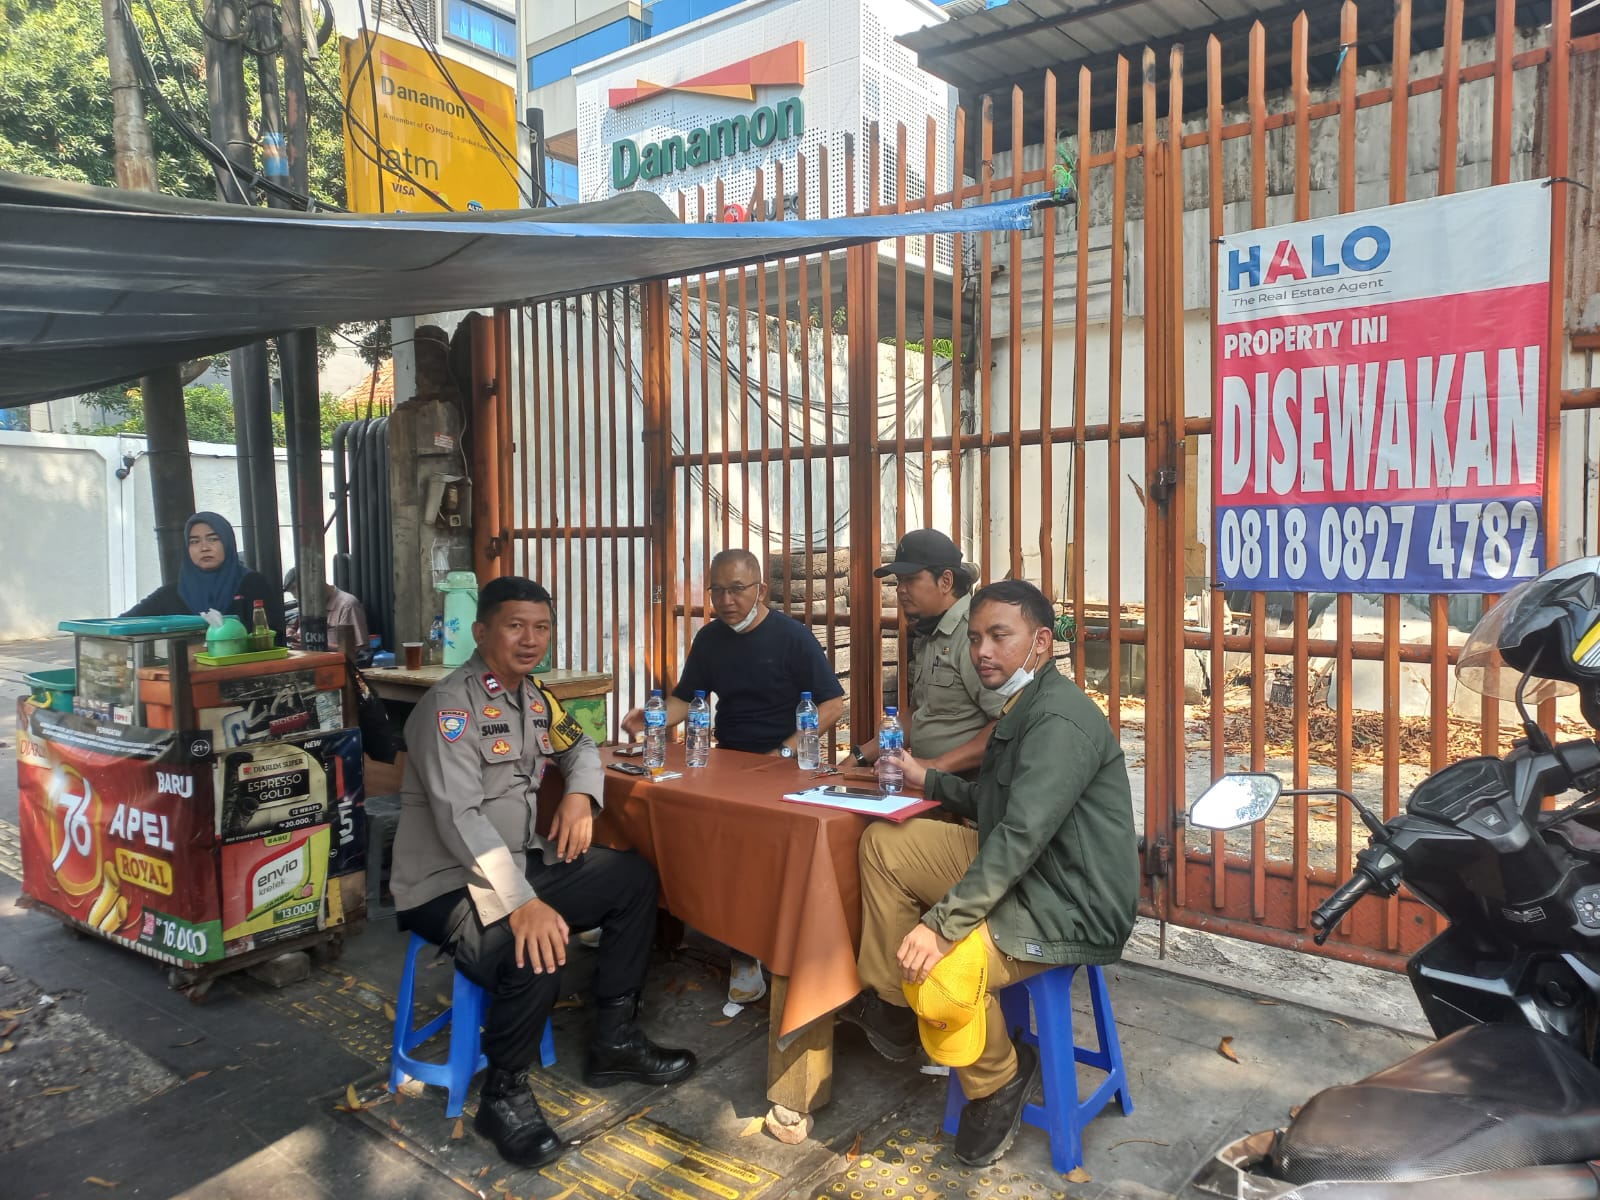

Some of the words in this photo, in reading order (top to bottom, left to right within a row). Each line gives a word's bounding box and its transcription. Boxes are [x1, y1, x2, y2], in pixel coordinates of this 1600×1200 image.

[381, 75, 465, 119] Danamon
[612, 97, 804, 189] Danamon
[386, 147, 439, 181] atm
[392, 182, 416, 197] VISA
[1228, 225, 1391, 291] HALO
[1232, 296, 1255, 308] The
[1258, 290, 1287, 302] Real
[1291, 284, 1335, 299] Estate
[1338, 278, 1384, 293] Agent
[1224, 320, 1344, 360] PROPERTY
[1351, 315, 1388, 346] INI
[1221, 345, 1540, 496] DISEWAKAN
[1220, 507, 1307, 580] 0818
[1319, 505, 1416, 580] 0827
[1428, 500, 1540, 580] 4782
[192, 743, 209, 753] 21+
[303, 740, 322, 750] NEW
[156, 771, 193, 798] BARU
[247, 773, 302, 793] ESPRESSO
[259, 787, 292, 801] GOLD
[52, 777, 92, 872] 76
[299, 804, 321, 814] WRAPS
[108, 803, 175, 851] APEL
[121, 854, 169, 888] ROYAL
[257, 858, 298, 888] envio
[281, 902, 314, 919] 13.000
